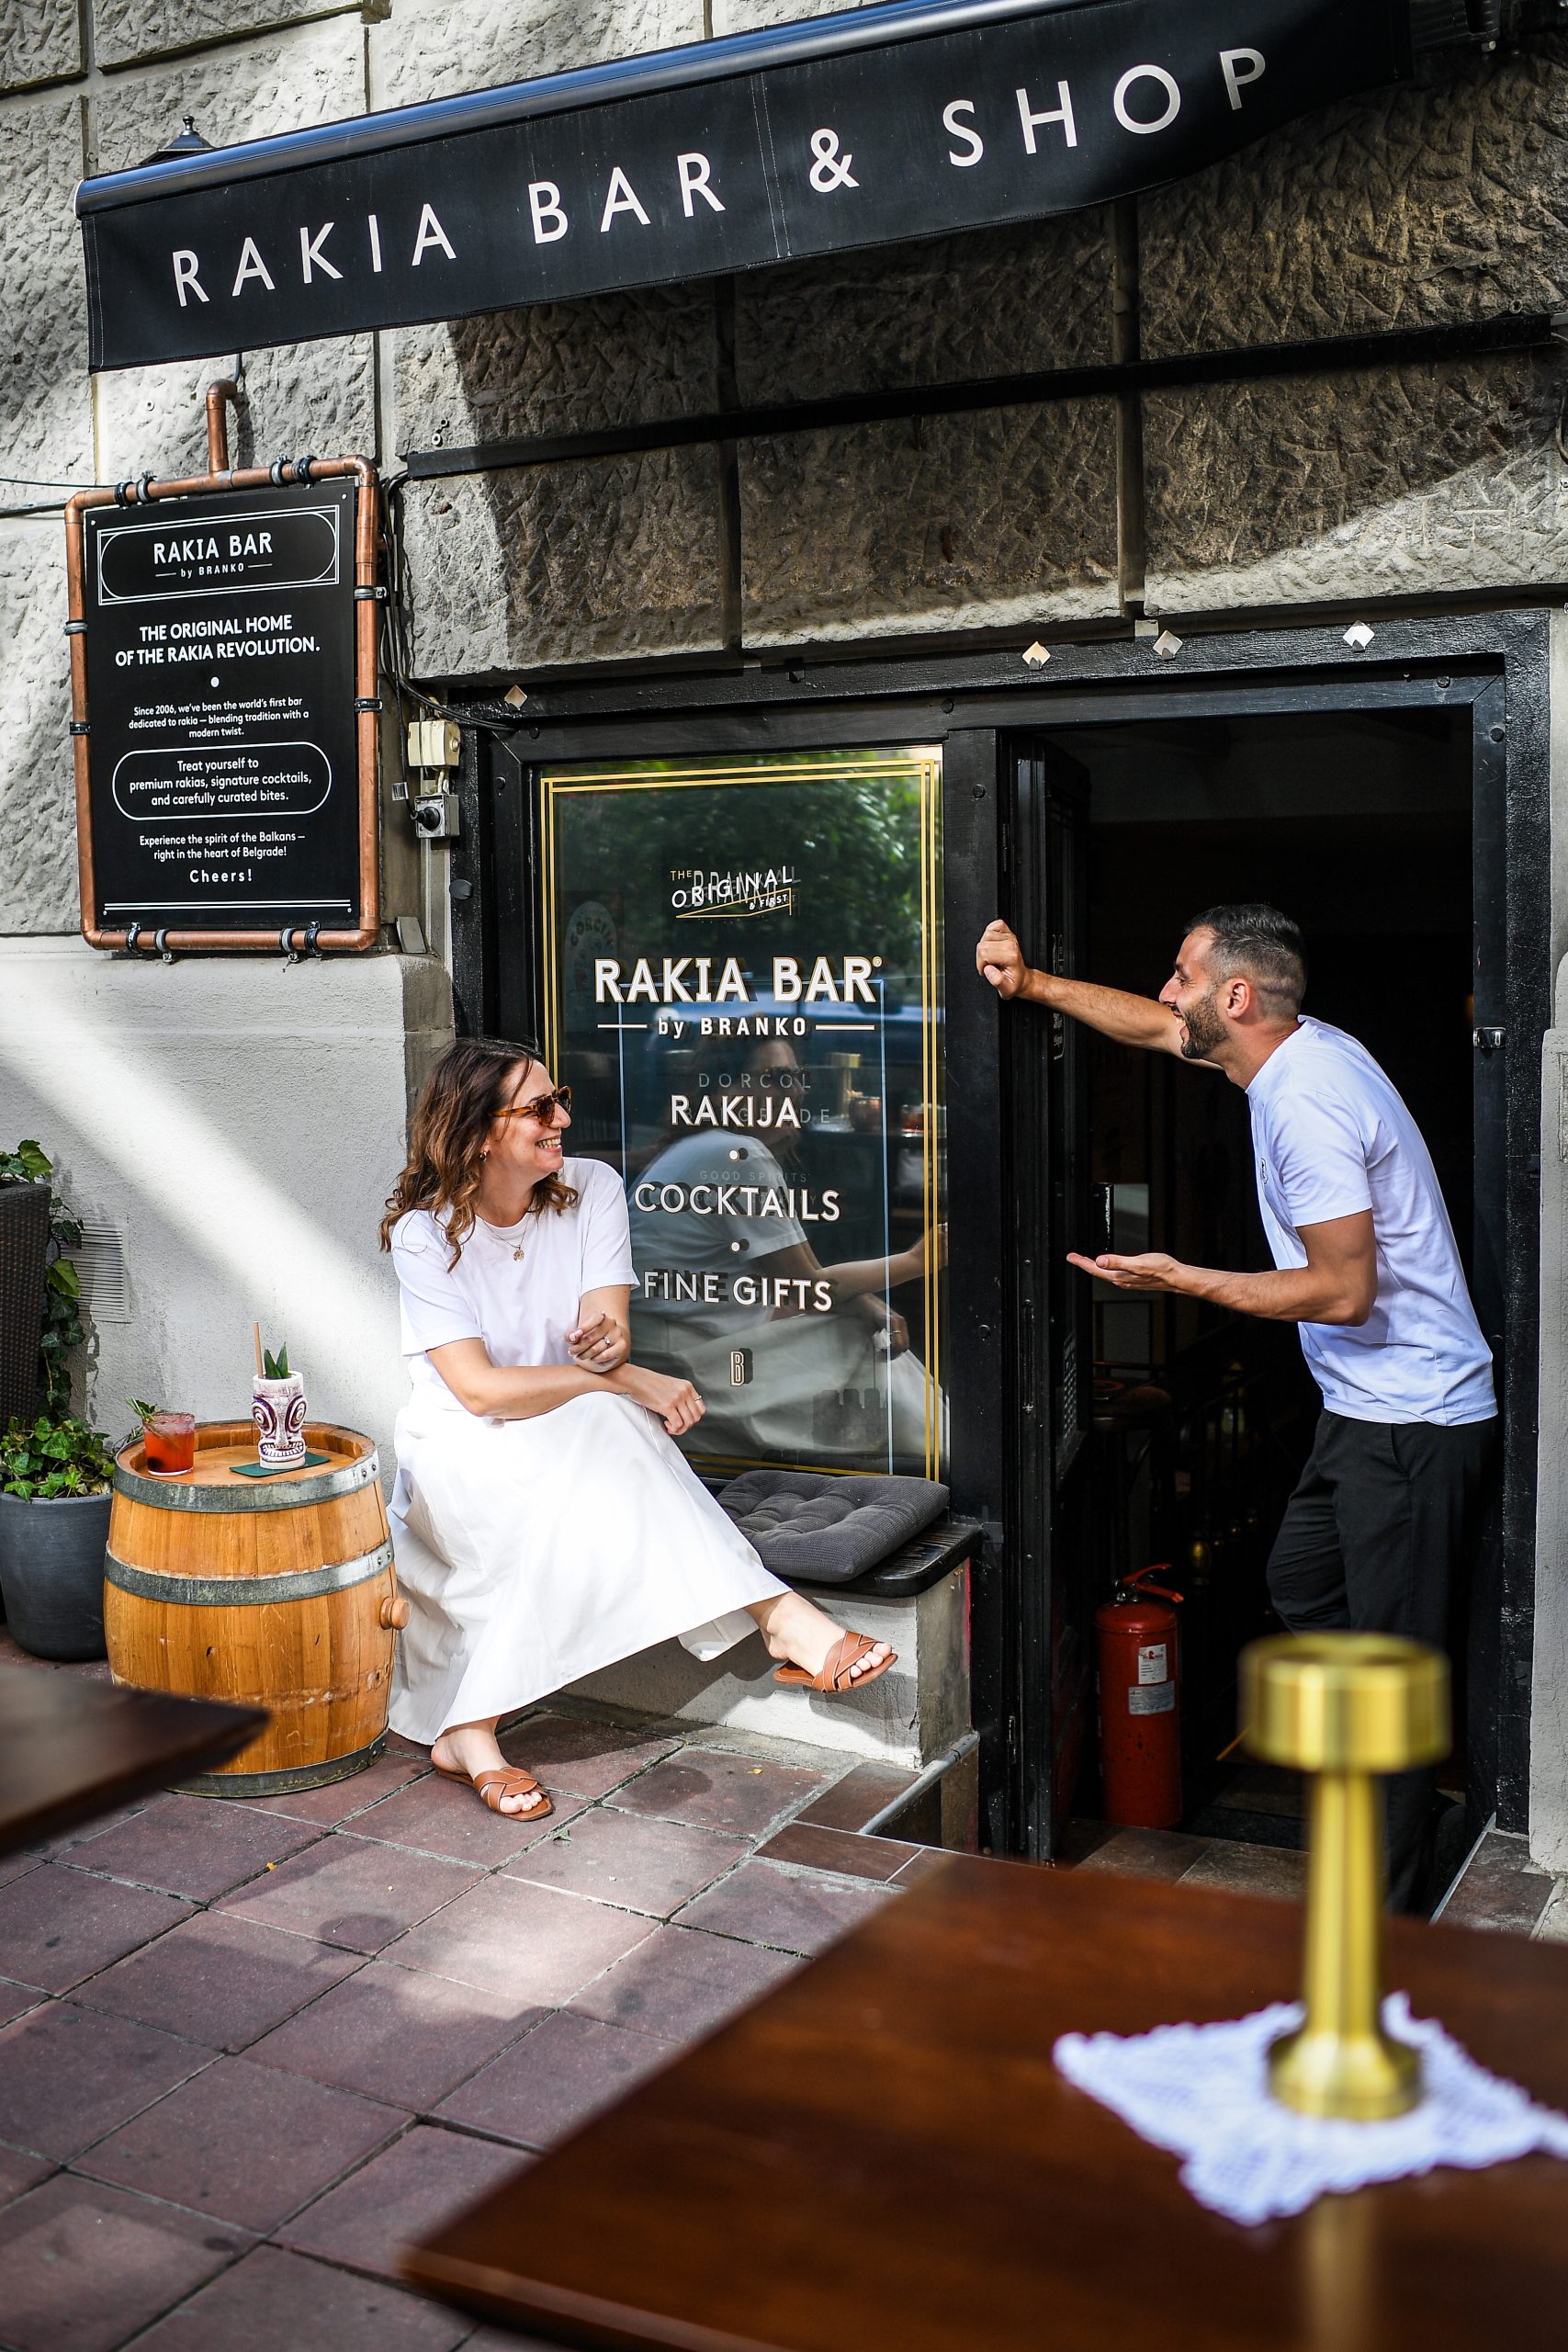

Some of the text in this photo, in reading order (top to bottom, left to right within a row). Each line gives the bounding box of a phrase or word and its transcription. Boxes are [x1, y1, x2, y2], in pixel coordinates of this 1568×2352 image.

[172, 47, 1266, 307] RAKIA BAR & SHOP
[153, 532, 273, 564] RAKIA BAR
[180, 562, 244, 579] by BRANKO
[140, 614, 292, 641] THE ORIGINAL HOME
[115, 636, 321, 667] OF THE RAKIA REVOLUTION.
[134, 696, 303, 717] Since 2006, we've been the world's first bar
[129, 718, 166, 729] dedicated
[167, 717, 176, 726] to
[178, 716, 198, 726] rakia
[208, 713, 243, 726] blending
[244, 711, 281, 722] tradition
[283, 709, 301, 719] with
[189, 727, 244, 738] modern twist.
[176, 757, 259, 774] Treat yourself to
[130, 772, 312, 794] premium rakias, signature cocktails,
[151, 789, 289, 807] and carefully curated bites.
[140, 835, 186, 848] Experience
[187, 834, 203, 844] the
[204, 832, 228, 846] spirit
[230, 832, 241, 843] of
[241, 832, 257, 842] the
[259, 831, 296, 842] Balkans
[154, 845, 287, 862] right in the heart of Belgrade!
[189, 868, 252, 883] Cheers!
[671, 870, 693, 881] THE
[671, 865, 794, 908] ORIGINAL
[760, 894, 789, 908] FIRST
[594, 957, 750, 1003] RAKIA
[658, 1016, 807, 1040] by BRANKO
[698, 1073, 811, 1089] DORCOL
[671, 1094, 802, 1129] RAKIJA
[700, 1170, 740, 1182] GOOD
[634, 1182, 841, 1223] COCKTAILS
[643, 1271, 832, 1312] FINE GIFTS
[730, 1351, 746, 1387] B
